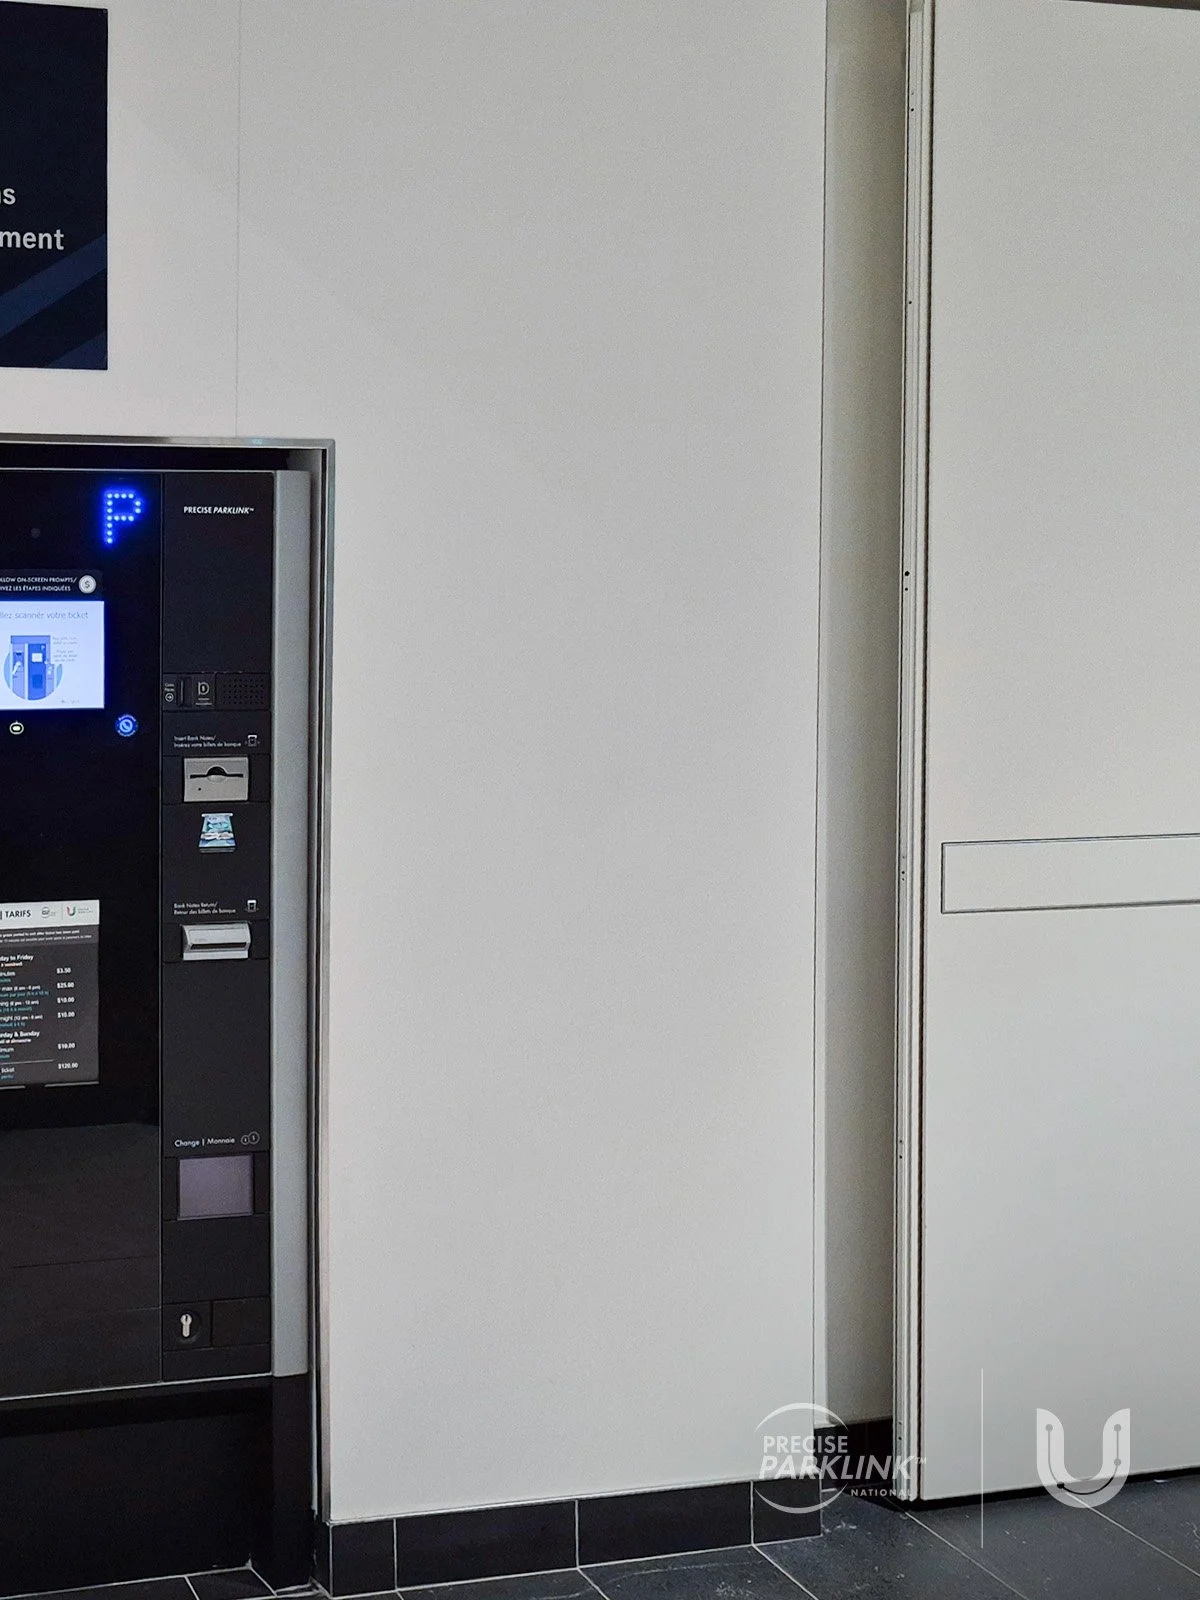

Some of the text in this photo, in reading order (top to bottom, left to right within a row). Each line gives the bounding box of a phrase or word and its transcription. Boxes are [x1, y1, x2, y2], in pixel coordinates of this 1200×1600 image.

[183, 506, 212, 514] PRECISE
[105, 491, 143, 545] P
[68, 611, 88, 619] ticket
[5, 909, 32, 918] TARIFS
[174, 1139, 200, 1148] Change
[207, 1137, 235, 1145] Monnaie
